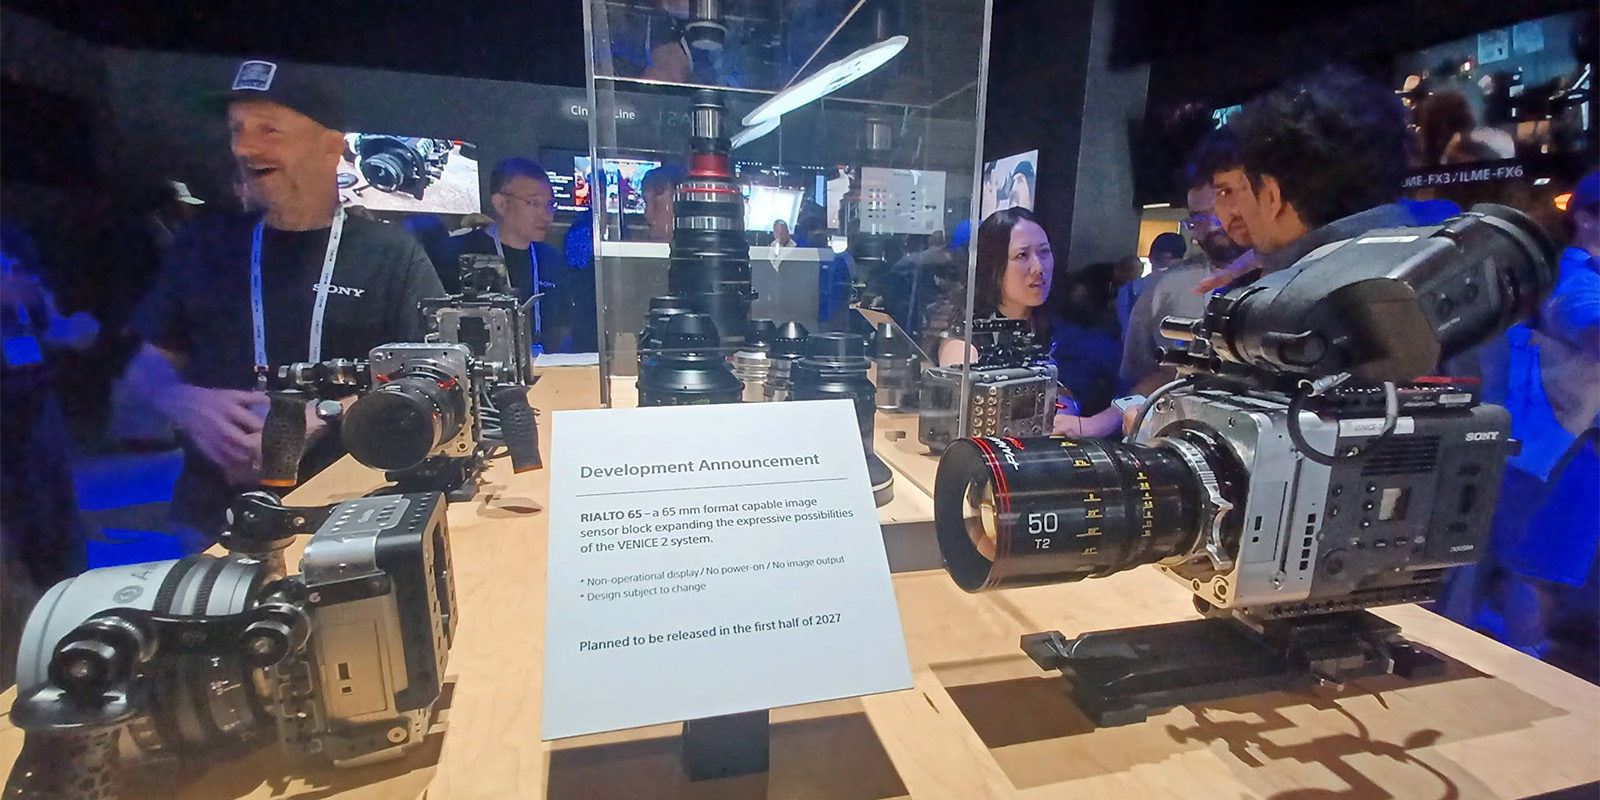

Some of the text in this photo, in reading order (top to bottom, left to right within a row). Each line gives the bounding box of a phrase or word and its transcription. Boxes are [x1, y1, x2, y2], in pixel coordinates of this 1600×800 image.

[615, 109, 636, 120] ine
[312, 283, 365, 298] SONY
[1465, 431, 1499, 442] SONY
[580, 452, 820, 479] Development Announcement
[580, 510, 625, 523] RIALTO
[627, 508, 642, 519] 65
[652, 509, 659, 517] a
[661, 506, 676, 517] 65
[678, 506, 700, 516] mm
[703, 503, 739, 514] format
[741, 499, 783, 513] capable
[784, 497, 818, 510] image
[580, 507, 854, 538] sensor block expanding the expressive possibilities
[1028, 512, 1058, 535] 50
[580, 533, 714, 553] of the VENICE 2 system.
[1035, 538, 1051, 550] T2
[586, 570, 665, 586] Non-operational
[705, 566, 719, 575] No
[721, 563, 765, 575] power-on
[772, 560, 785, 569] No
[786, 559, 814, 569] image
[815, 555, 845, 566] output
[586, 582, 707, 602] Design subject to change
[579, 612, 841, 652] Planned to be released in the first half of 2027
